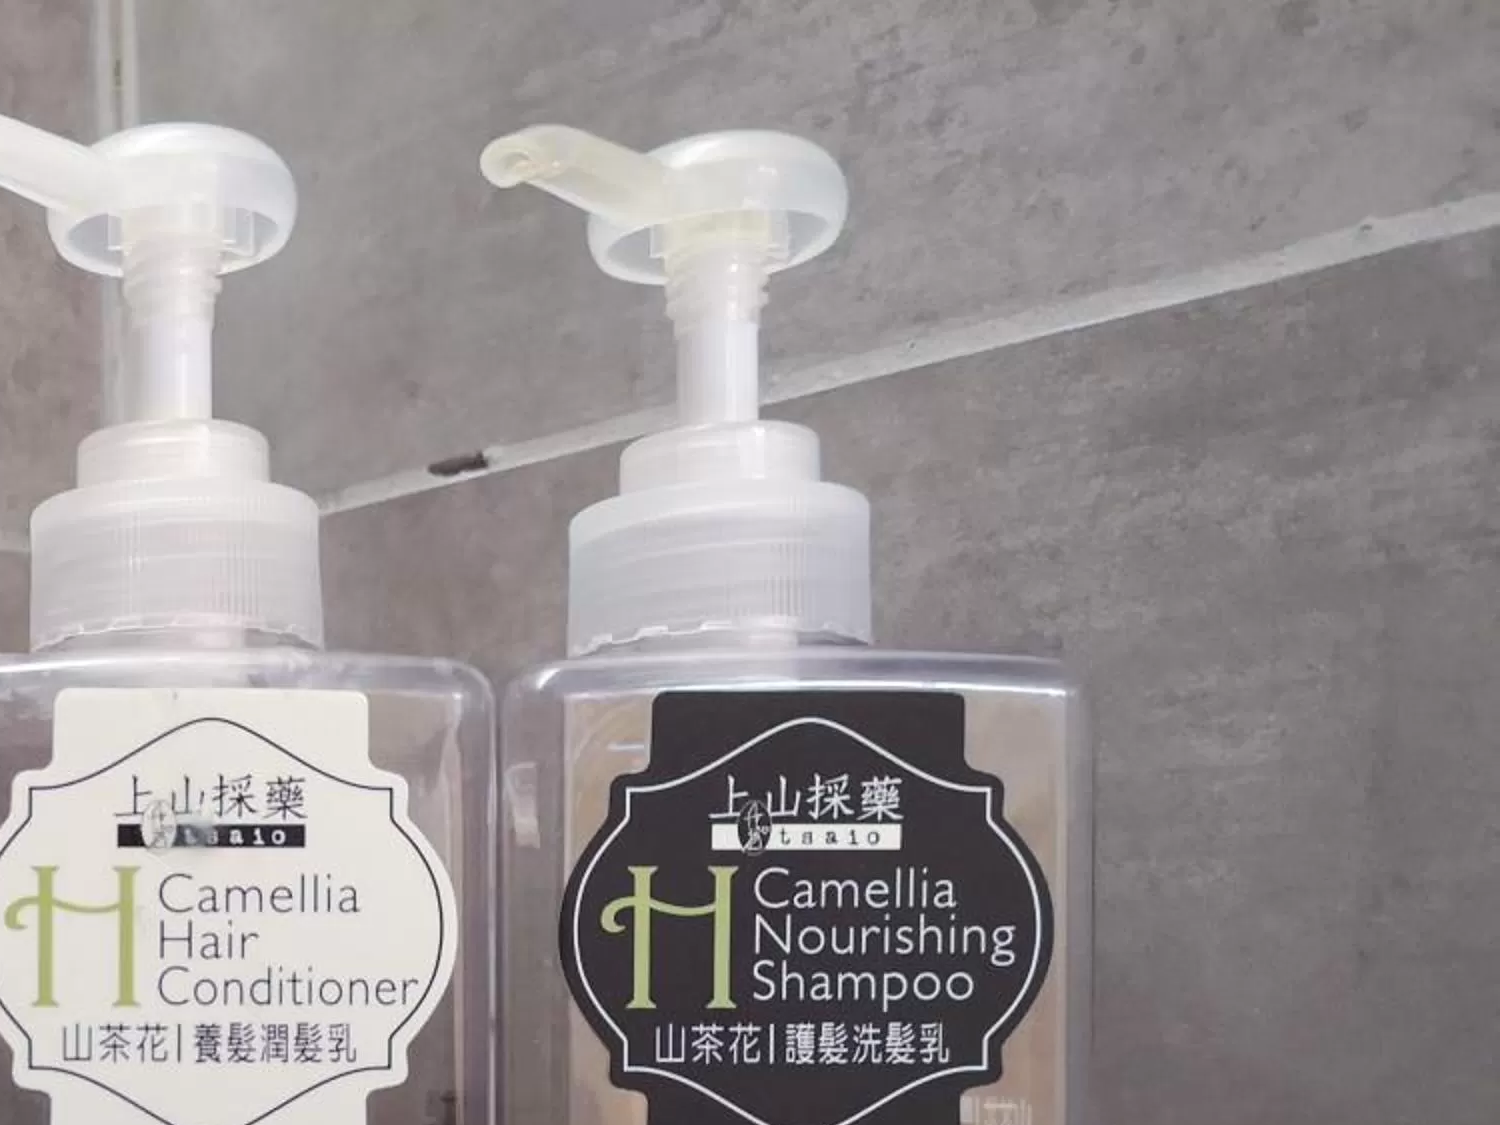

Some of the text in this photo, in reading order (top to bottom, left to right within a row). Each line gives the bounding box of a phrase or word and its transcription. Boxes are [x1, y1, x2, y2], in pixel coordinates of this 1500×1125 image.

[113, 773, 308, 820] 上山採藥
[708, 772, 905, 821] 上山採藥
[780, 827, 880, 845] tsaio
[157, 872, 361, 915] Camellia
[753, 866, 958, 910] Camellia
[5, 865, 142, 1007] H
[157, 919, 260, 960] Hair
[600, 864, 739, 1009] H
[754, 913, 1017, 966] Nourishing
[157, 965, 419, 1007] Conditioner
[752, 959, 975, 1012] Shampoo
